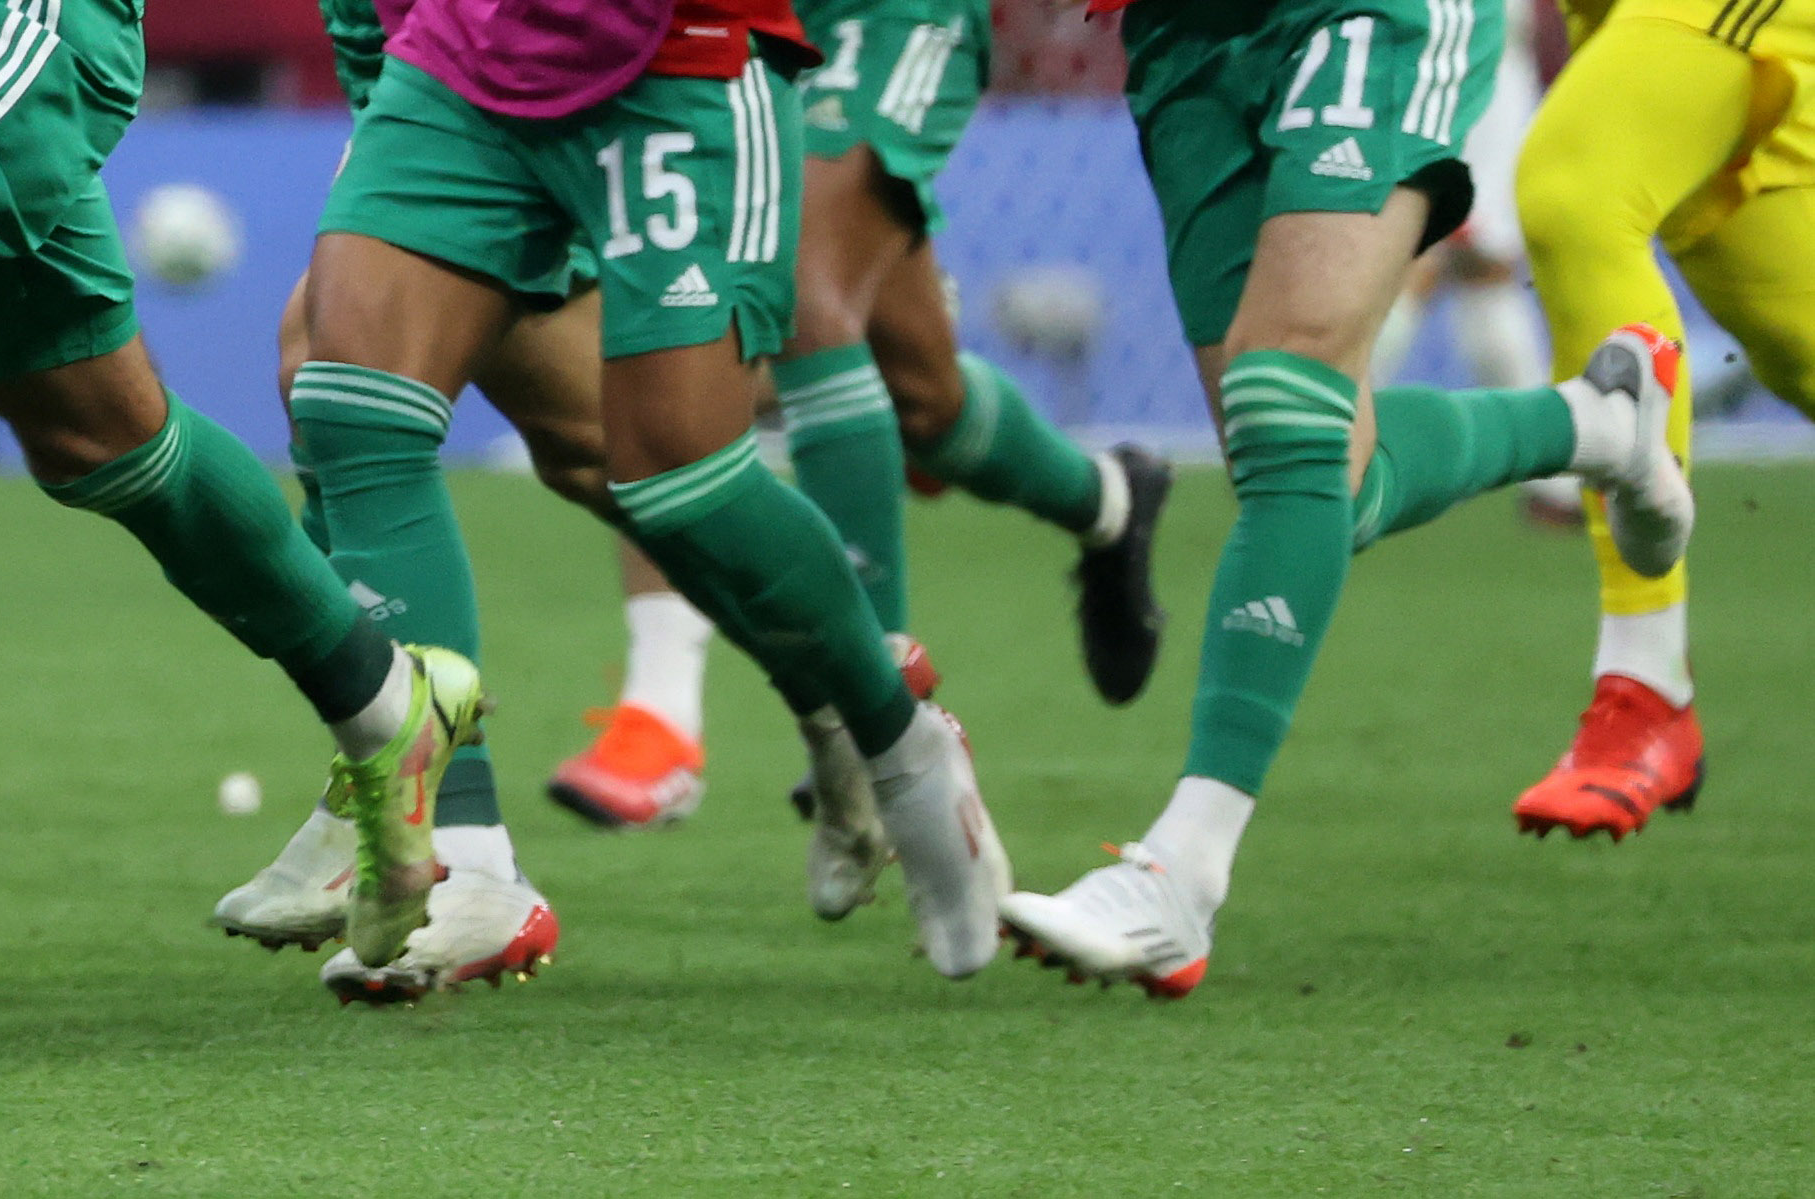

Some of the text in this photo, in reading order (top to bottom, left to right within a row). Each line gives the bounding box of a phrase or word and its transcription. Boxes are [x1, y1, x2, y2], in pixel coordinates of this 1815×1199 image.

[798, 19, 863, 92] 1
[1276, 15, 1374, 133] 21
[596, 131, 699, 260] 15
